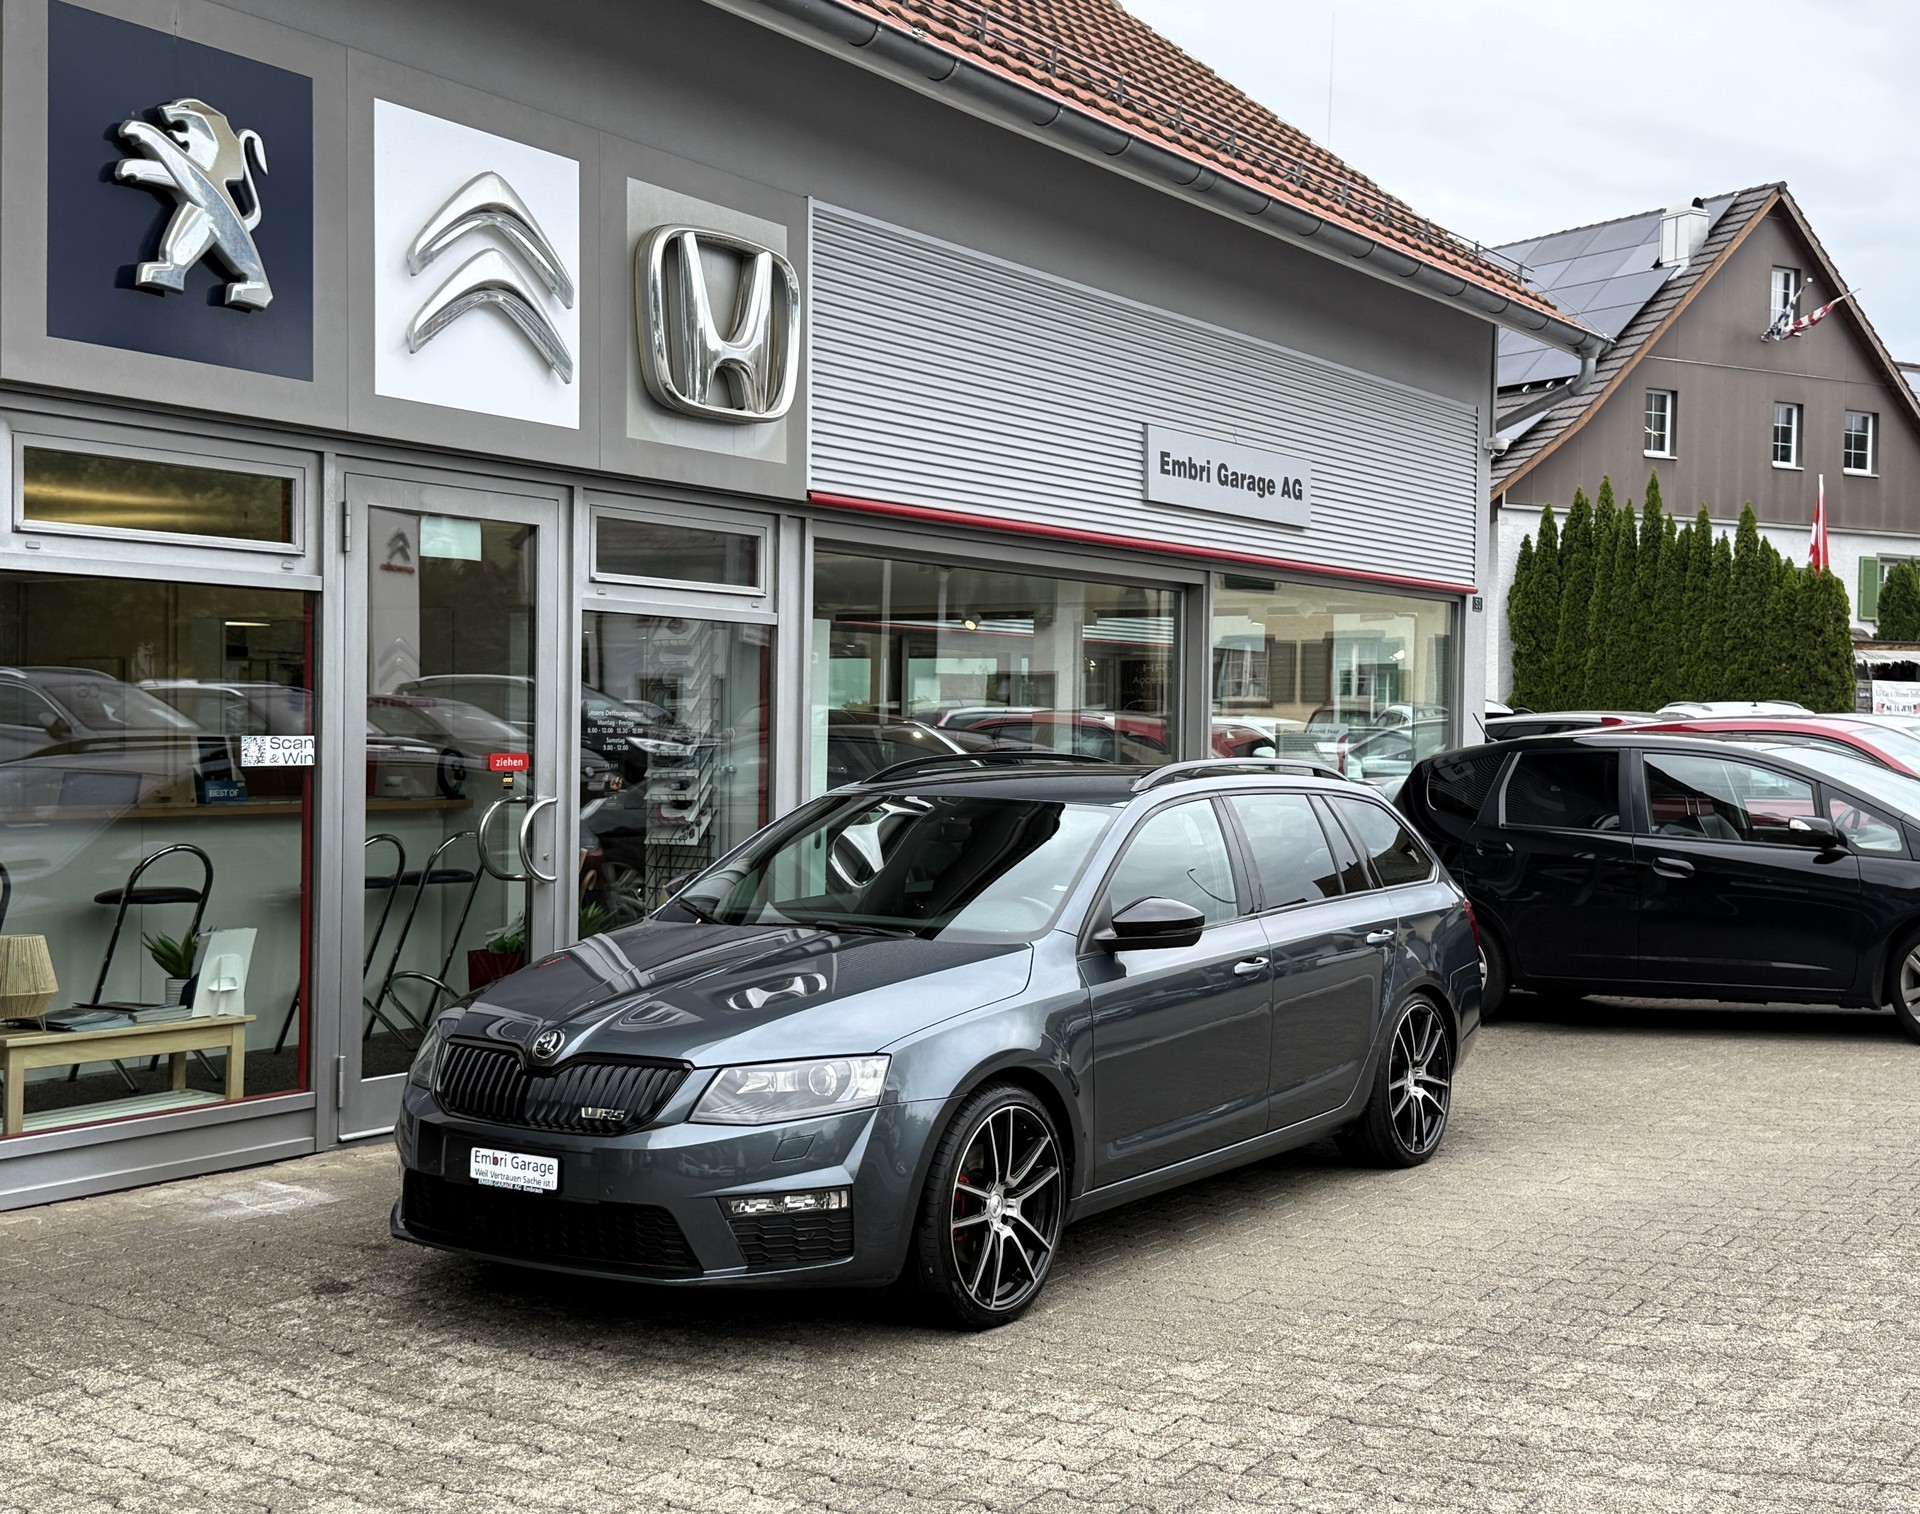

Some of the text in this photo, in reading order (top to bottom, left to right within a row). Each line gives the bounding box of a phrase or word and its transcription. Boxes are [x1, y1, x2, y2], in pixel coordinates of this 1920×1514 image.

[1160, 450, 1303, 501] Embri Garage AG
[618, 720, 635, 728] Freitag
[269, 736, 315, 750] Scan
[269, 750, 315, 765] & Win
[495, 756, 524, 767] ziehen
[209, 789, 240, 797] BEST OF
[474, 1149, 554, 1177] Embri Garage
[475, 1168, 489, 1178] Weil
[490, 1170, 522, 1183] Vertrauen
[523, 1175, 542, 1187] Sache
